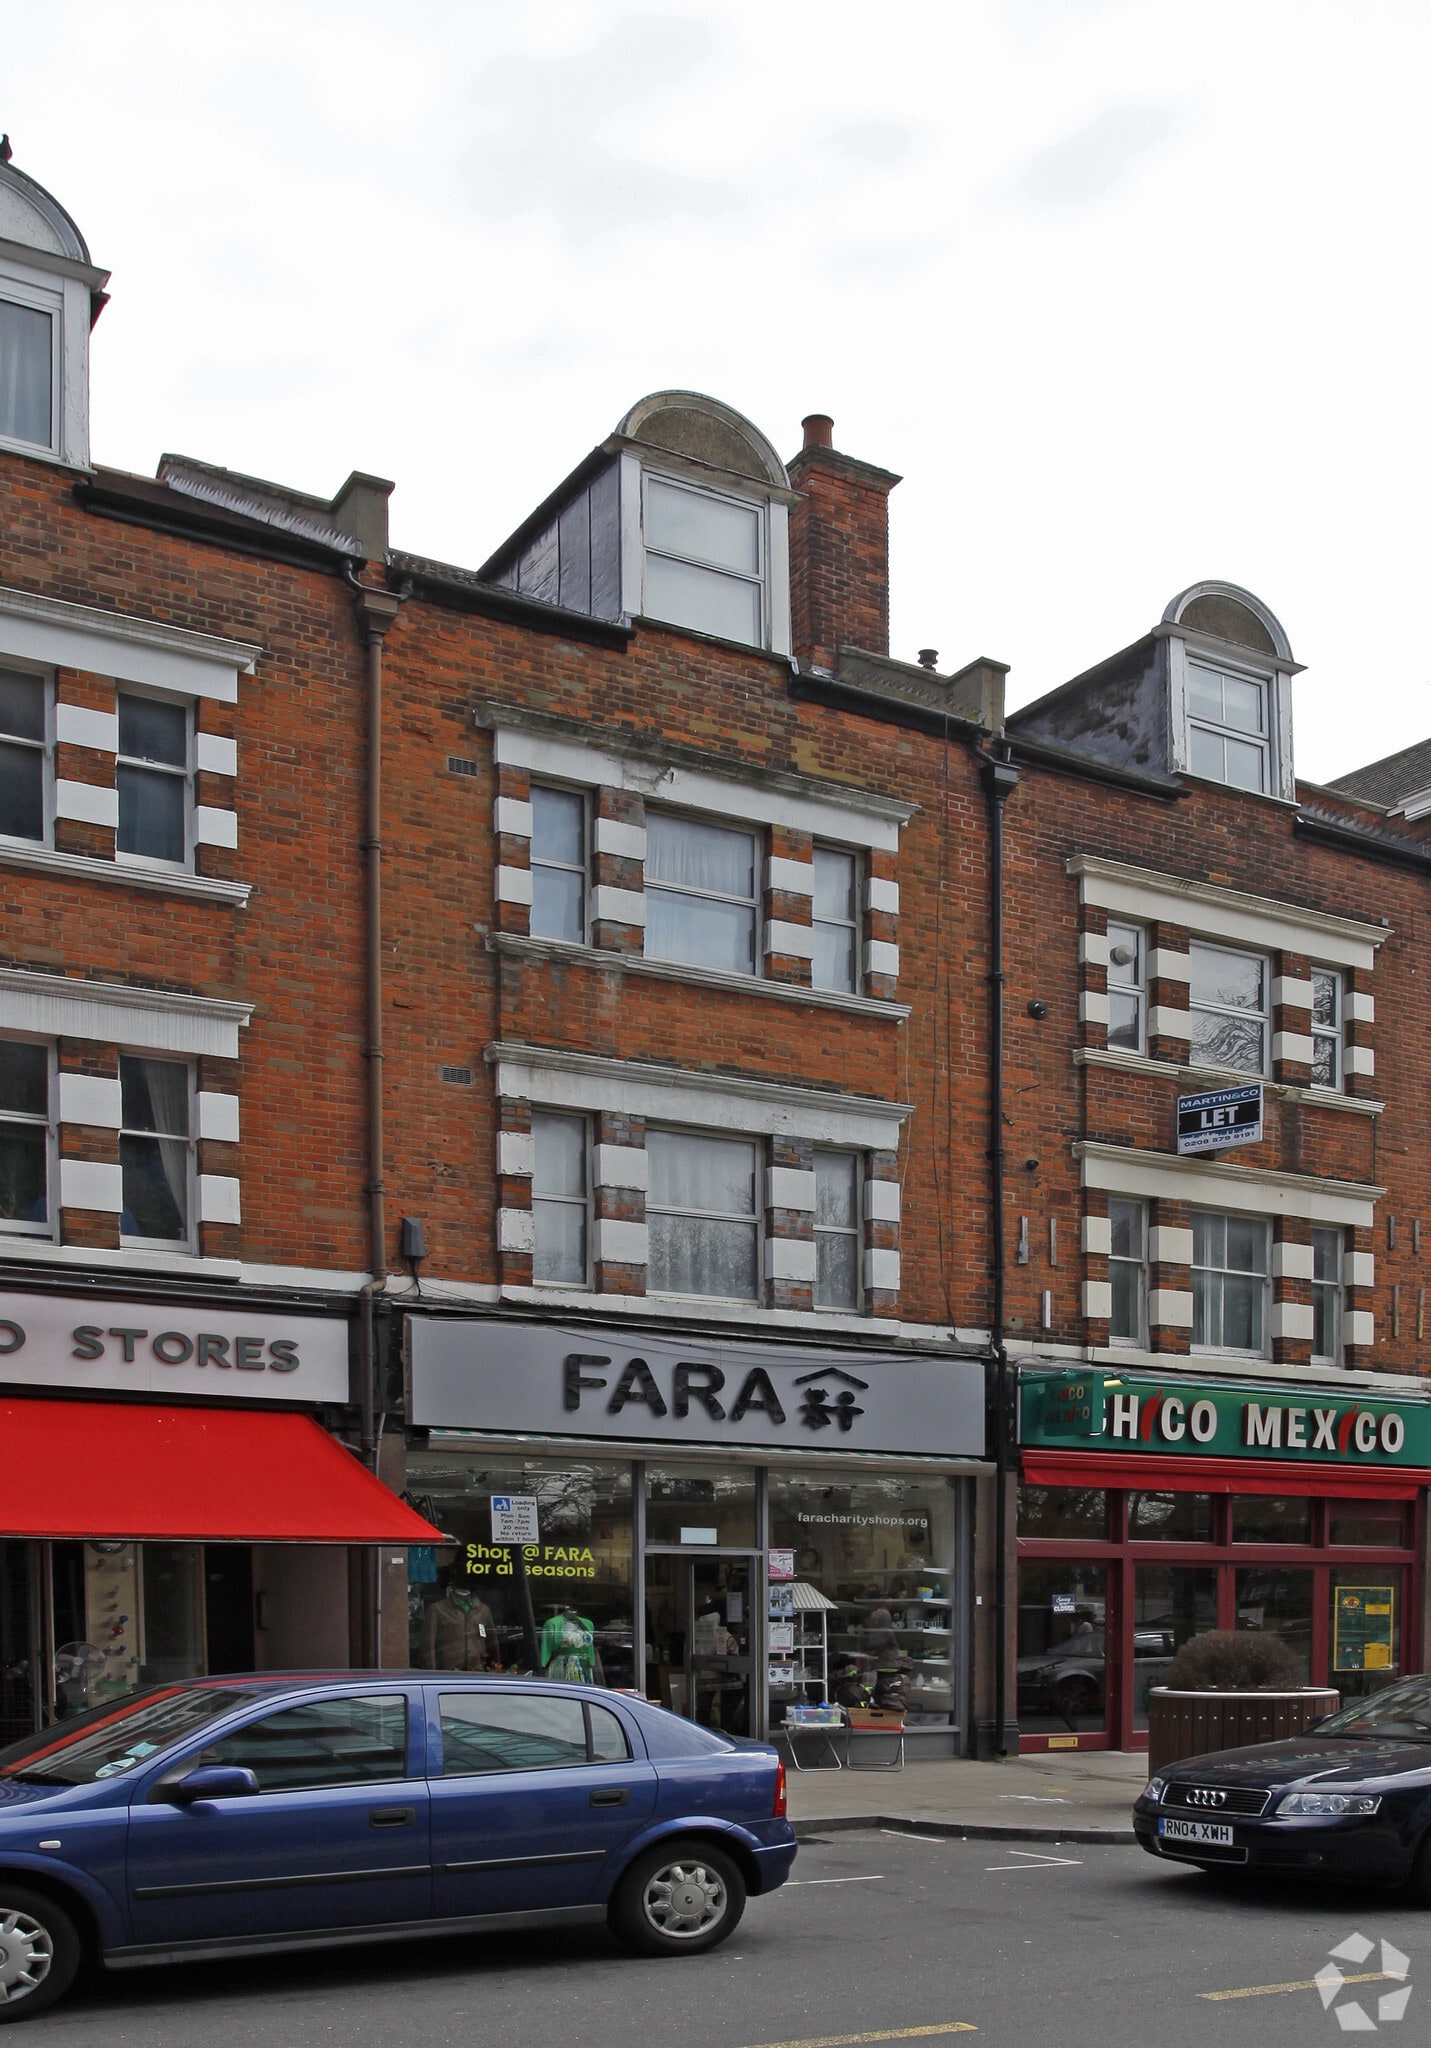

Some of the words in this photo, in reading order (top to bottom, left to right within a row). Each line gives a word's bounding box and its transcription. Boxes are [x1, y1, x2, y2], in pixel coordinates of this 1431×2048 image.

[1180, 1088, 1259, 1109] MARTIN&CO
[1200, 1105, 1239, 1129] LET
[1184, 1138, 1209, 1148] 0208
[72, 1325, 300, 1372] STORES
[564, 1353, 787, 1425] FARA
[1242, 1403, 1405, 1455] MEXICO
[797, 1512, 928, 1528] faracharityshops.org
[521, 1543, 540, 1561] @
[544, 1546, 595, 1562] FARA
[466, 1560, 491, 1574] for
[524, 1565, 596, 1578] seasons
[1166, 1820, 1198, 1837] RN04
[1201, 1825, 1229, 1841] XWH
